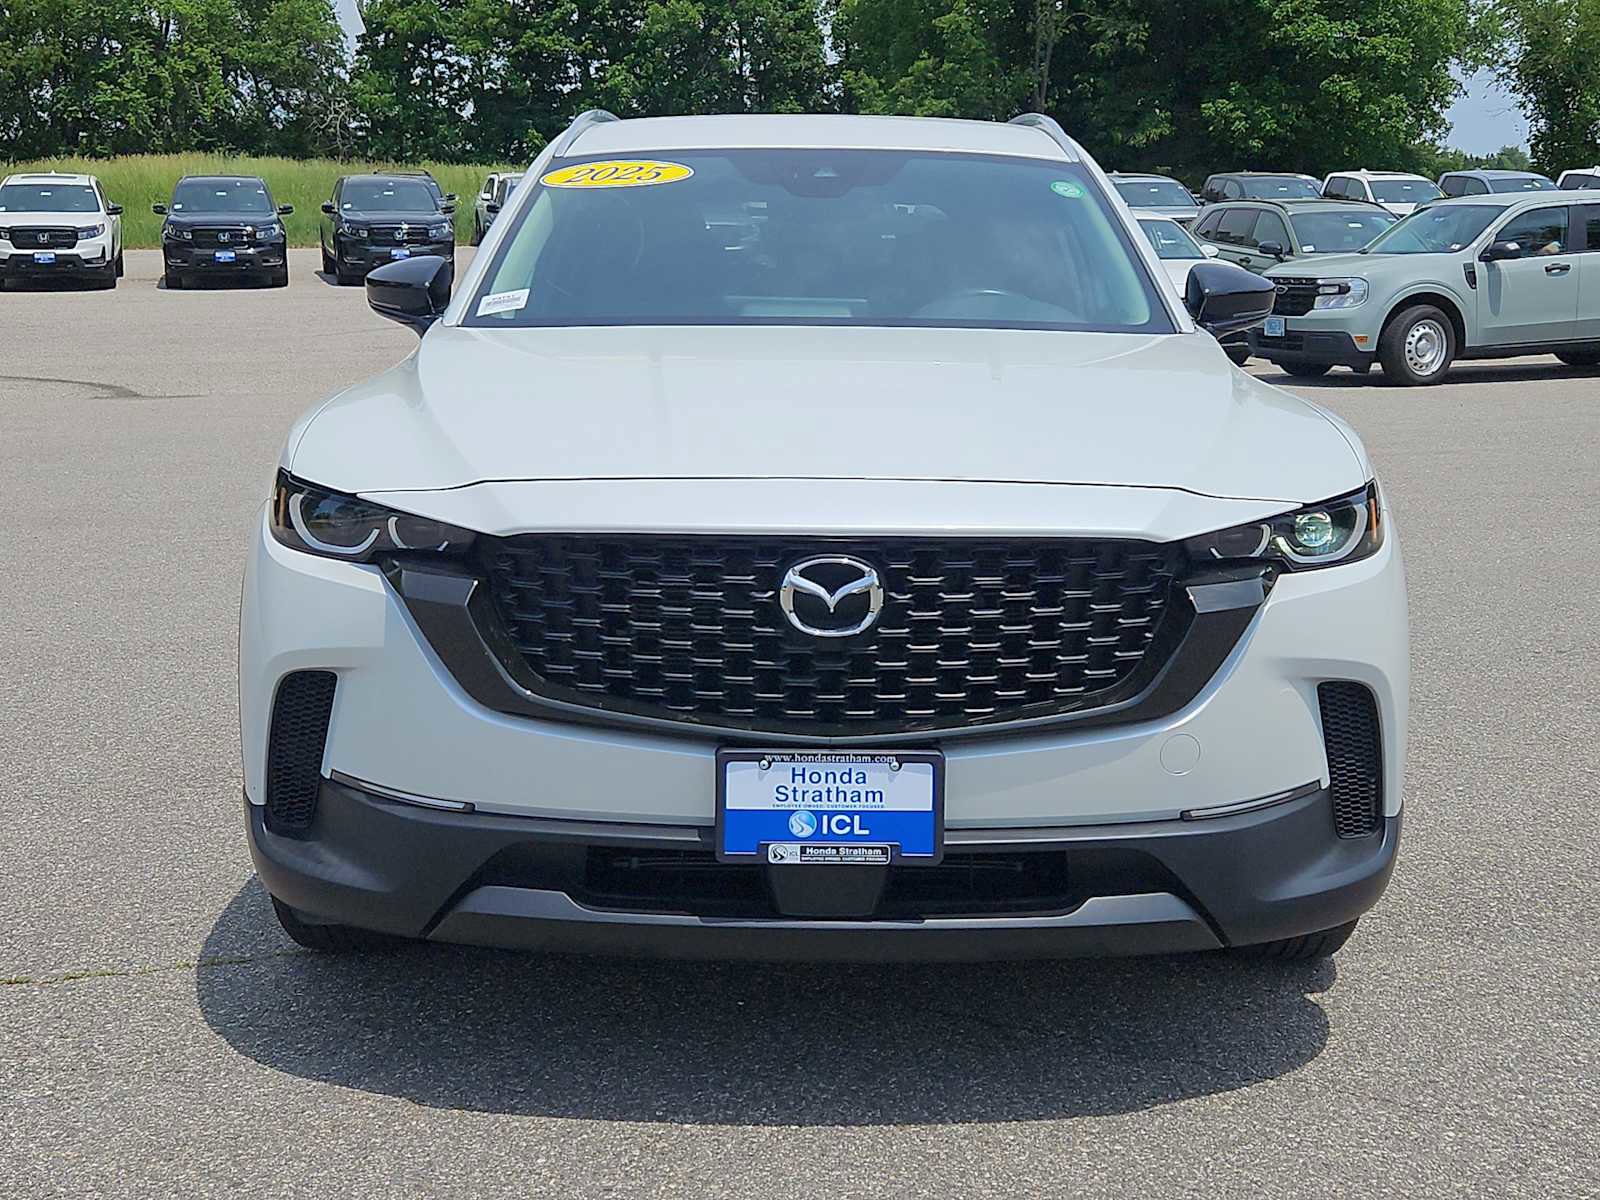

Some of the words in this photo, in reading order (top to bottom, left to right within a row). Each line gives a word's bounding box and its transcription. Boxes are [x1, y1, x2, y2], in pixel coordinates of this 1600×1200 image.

[564, 166, 670, 182] 2025
[764, 753, 897, 763] www.hondastratham.com
[791, 767, 867, 785] Honda
[775, 785, 883, 803] Stratham
[822, 815, 869, 834] ICL
[806, 847, 837, 855] Honda
[839, 847, 882, 855] Stratham
